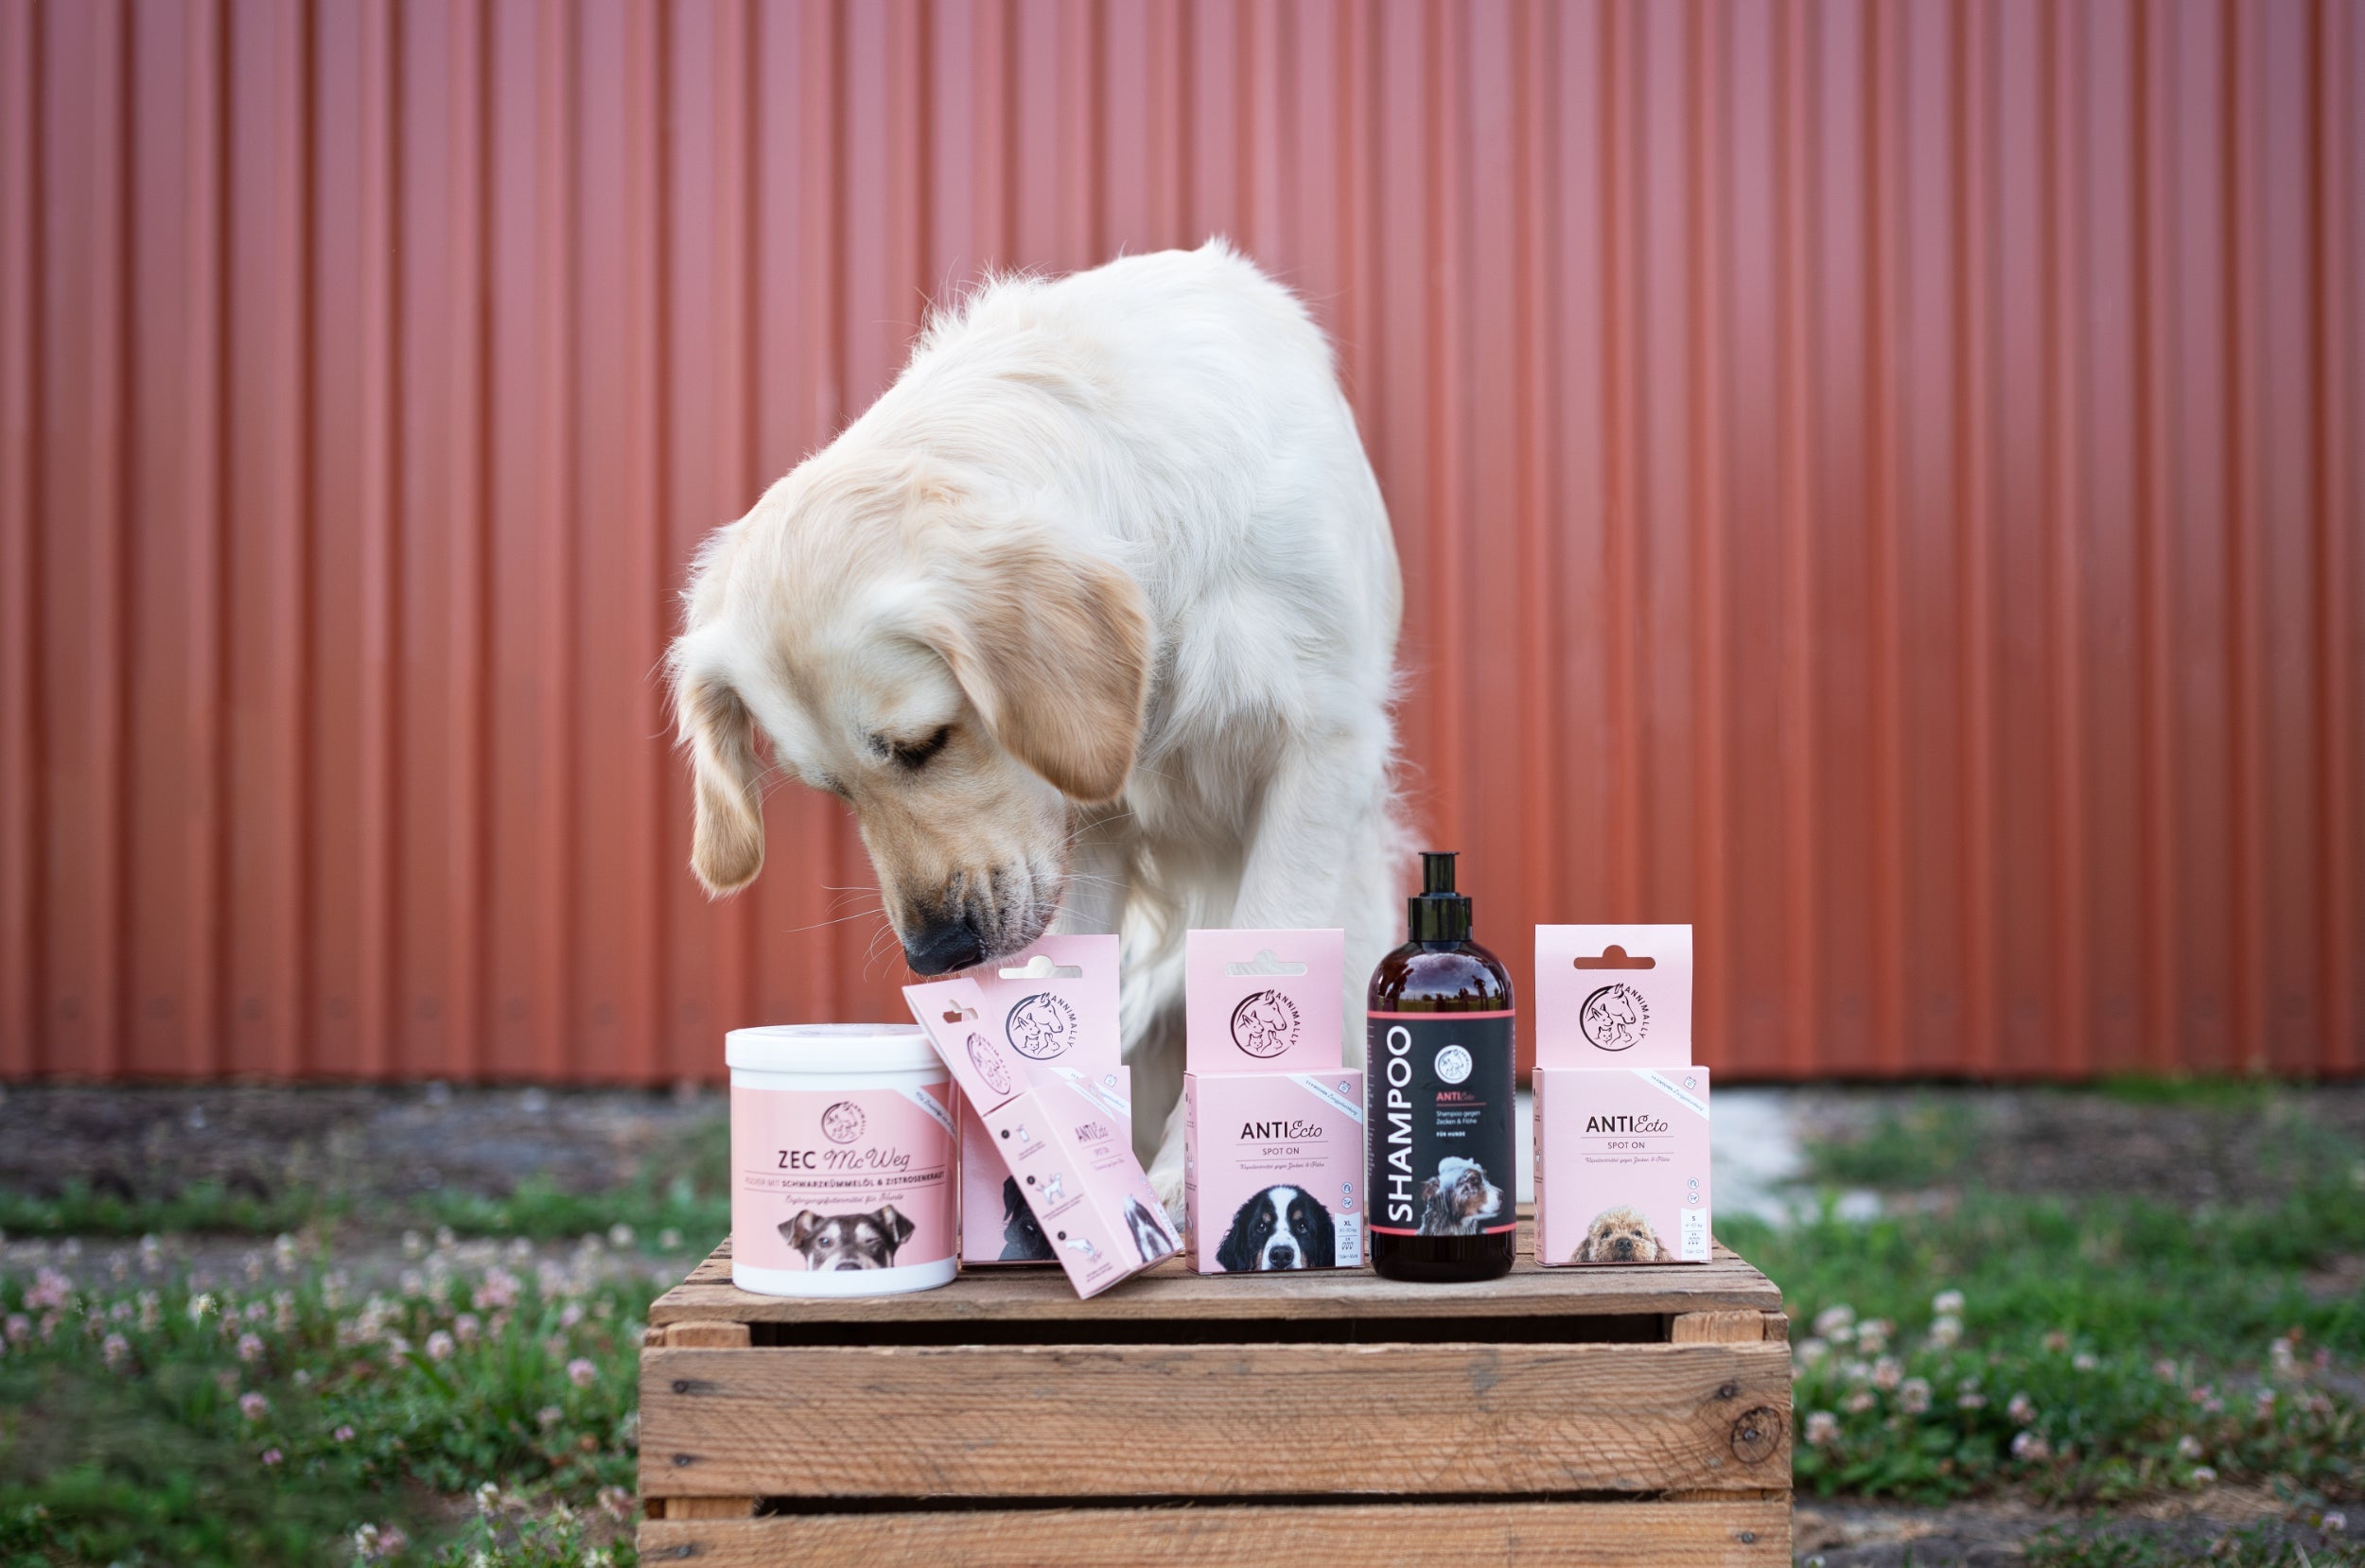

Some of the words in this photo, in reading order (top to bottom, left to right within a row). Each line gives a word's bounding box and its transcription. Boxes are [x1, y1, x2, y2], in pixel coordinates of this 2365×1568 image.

[1051, 995, 1077, 1048] ANNIMALLY
[1275, 992, 1301, 1046] ANNIMALLY
[1624, 985, 1650, 1039] ANNIMALLY
[1387, 1025, 1413, 1222] SHAMPOO
[778, 1150, 816, 1169] ZEC
[1262, 1147, 1284, 1156] SPOT
[1286, 1146, 1300, 1155] ON
[877, 1177, 884, 1186] &
[885, 1171, 945, 1186] ZISTROSENKRAUT
